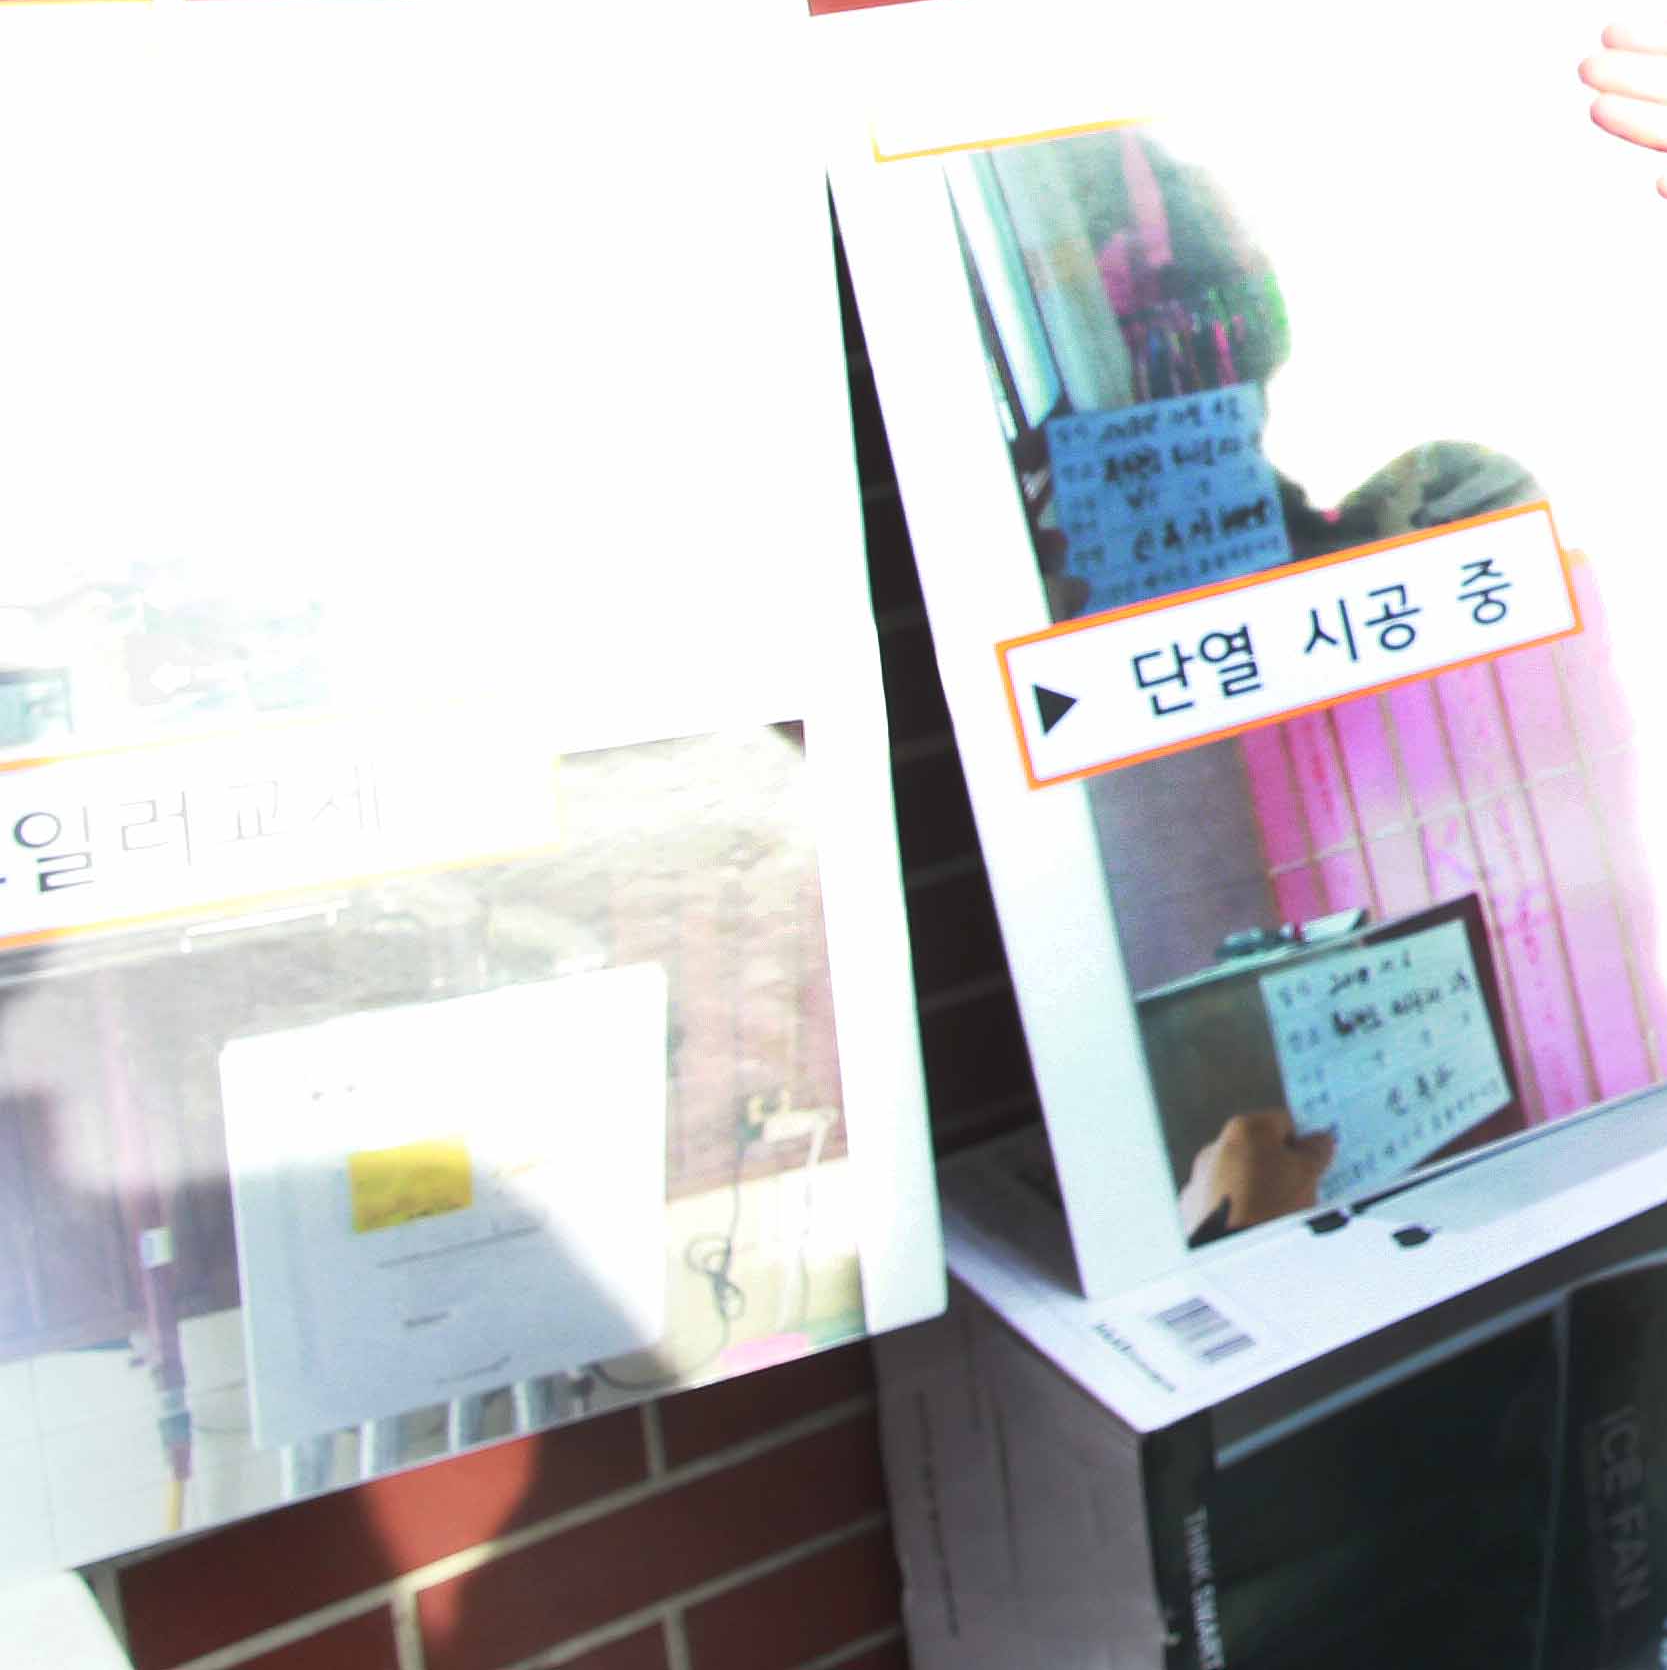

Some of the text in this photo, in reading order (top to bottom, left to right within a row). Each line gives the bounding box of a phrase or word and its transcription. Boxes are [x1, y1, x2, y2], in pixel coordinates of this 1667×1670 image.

[1131, 557, 1514, 717] 단열 시공 중
